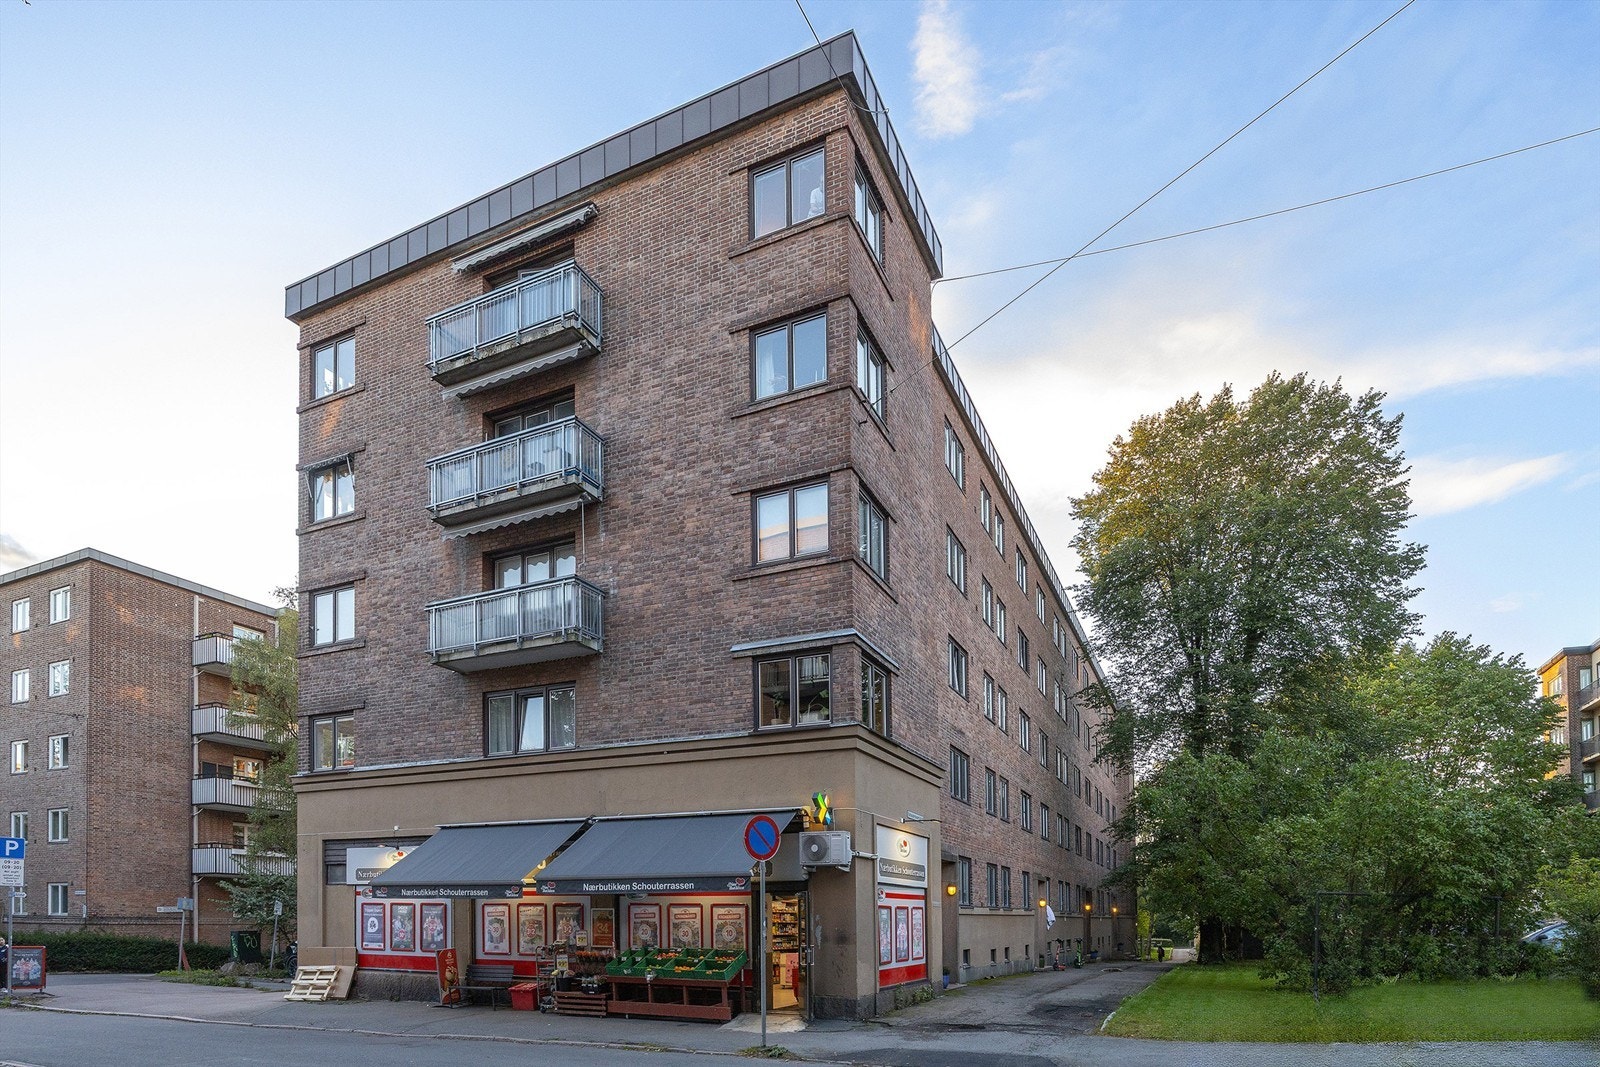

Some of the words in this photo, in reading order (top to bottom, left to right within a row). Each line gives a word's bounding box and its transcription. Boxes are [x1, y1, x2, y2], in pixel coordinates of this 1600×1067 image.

[5, 840, 19, 856] P
[583, 883, 630, 891] Nærbutikken
[631, 882, 694, 891] Schouterrassen
[401, 888, 438, 896] Nærbutikken
[438, 888, 489, 896] Schouterrassen
